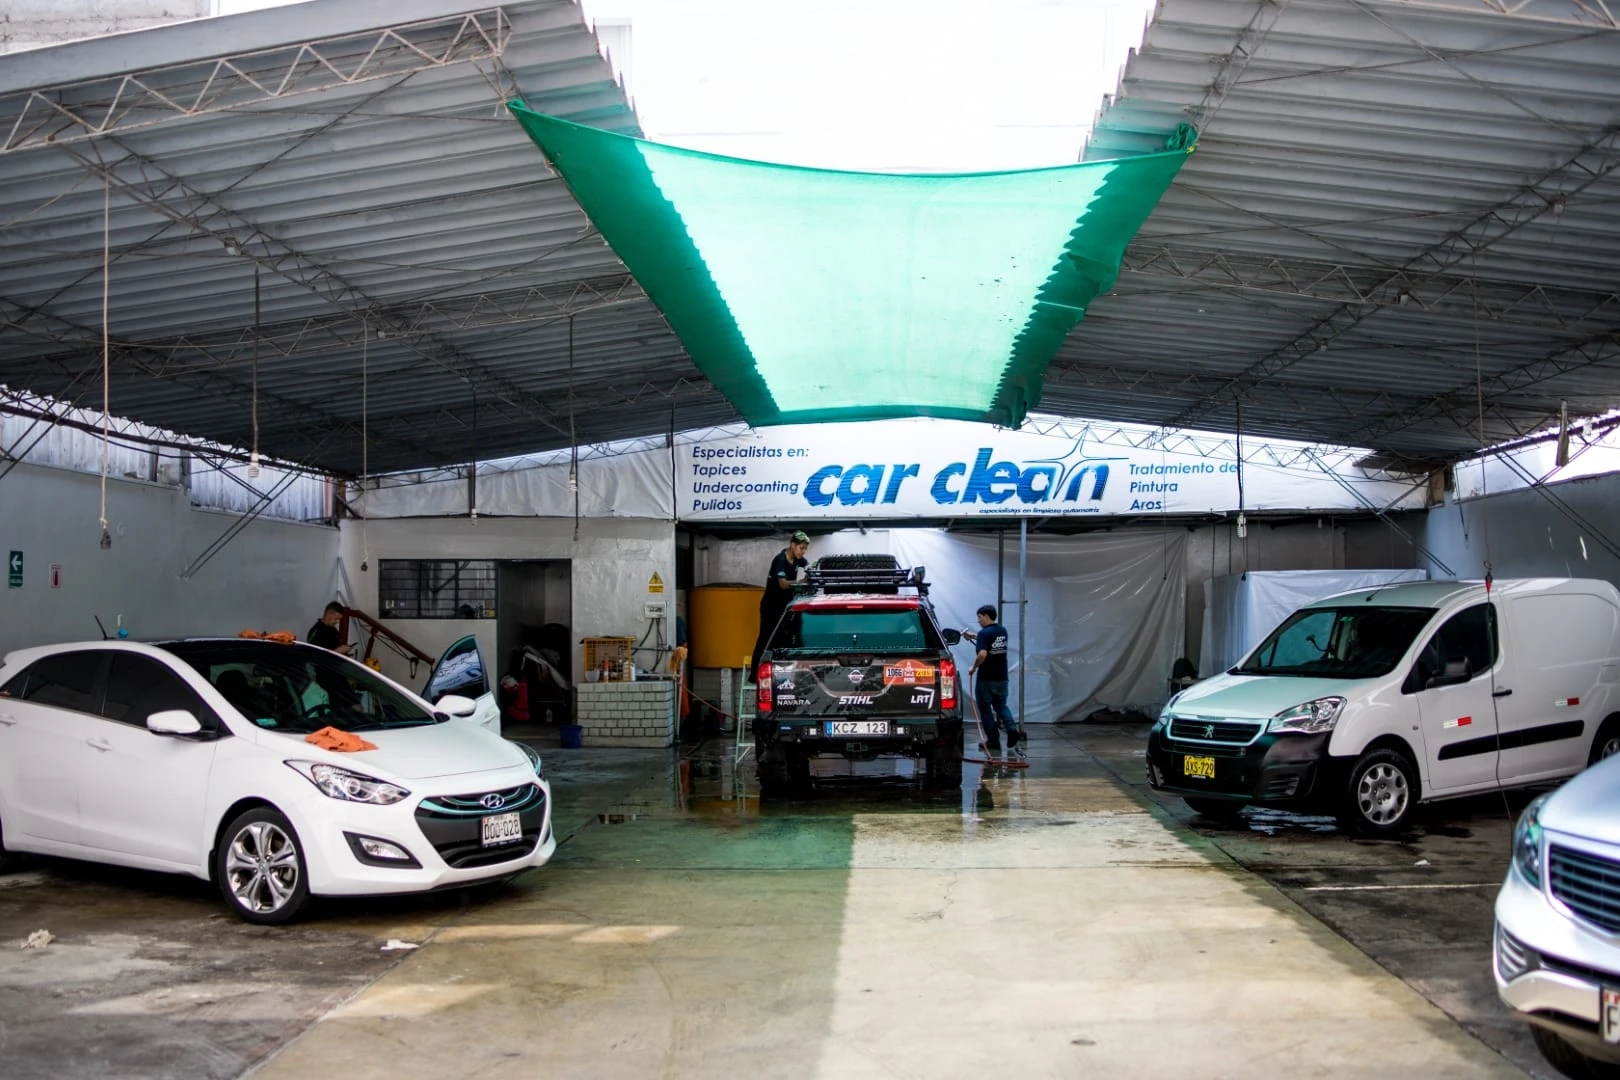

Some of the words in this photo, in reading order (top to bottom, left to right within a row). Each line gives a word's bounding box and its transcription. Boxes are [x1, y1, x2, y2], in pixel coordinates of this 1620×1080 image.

[692, 446, 782, 460] Especialistas
[787, 447, 810, 458] en:
[692, 463, 747, 476] Tapices
[1129, 463, 1220, 475] Tratamiento
[803, 463, 920, 507] car
[930, 446, 1110, 505] clean
[692, 481, 799, 494] Undercoanting
[1130, 481, 1178, 493] Pintura
[692, 498, 742, 511] Pulidos
[1130, 499, 1163, 511] Aros
[839, 695, 874, 705] STIHL
[910, 694, 931, 704] LRT
[833, 723, 858, 733] KCZ
[866, 722, 887, 733] 123
